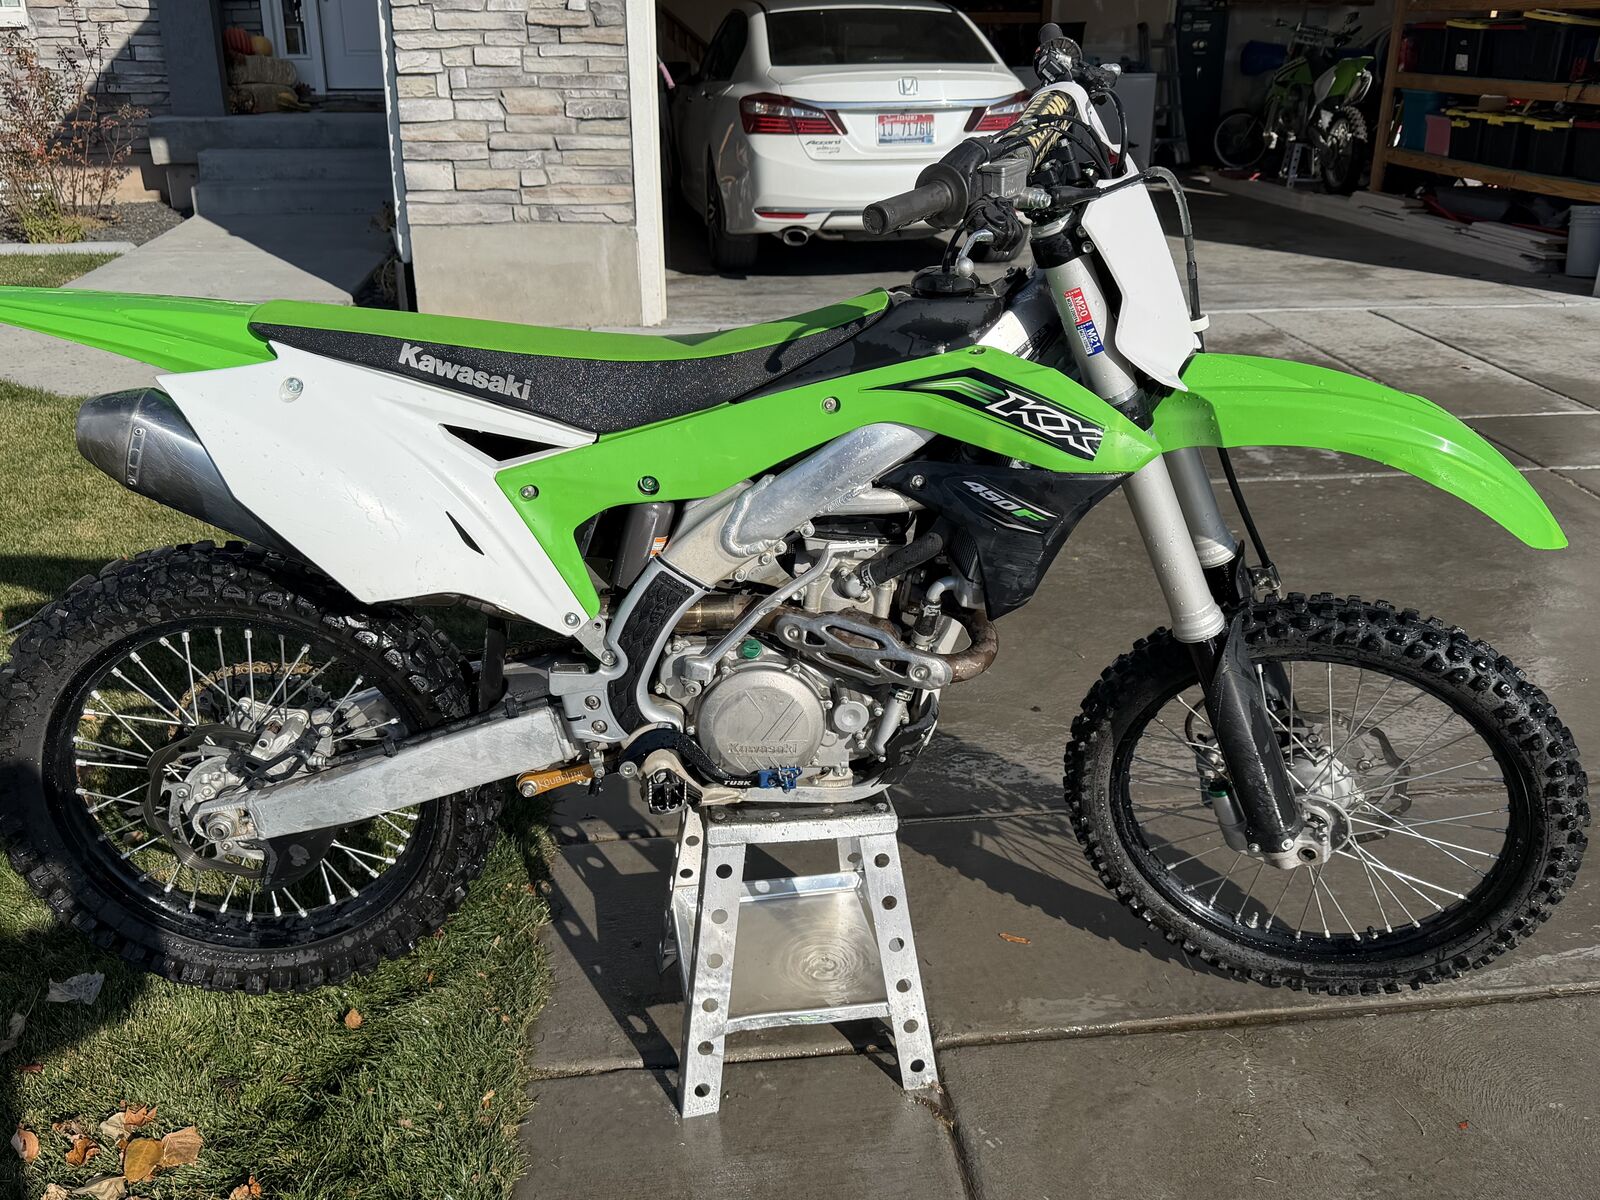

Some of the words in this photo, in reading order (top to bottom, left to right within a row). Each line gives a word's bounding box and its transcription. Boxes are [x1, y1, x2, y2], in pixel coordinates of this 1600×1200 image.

[1074, 295, 1088, 317] M20
[1086, 327, 1101, 347] M21
[398, 342, 532, 401] Kawasaki
[984, 389, 1104, 456] KX
[962, 480, 1048, 521] 450F
[727, 742, 798, 754] Kawasaki
